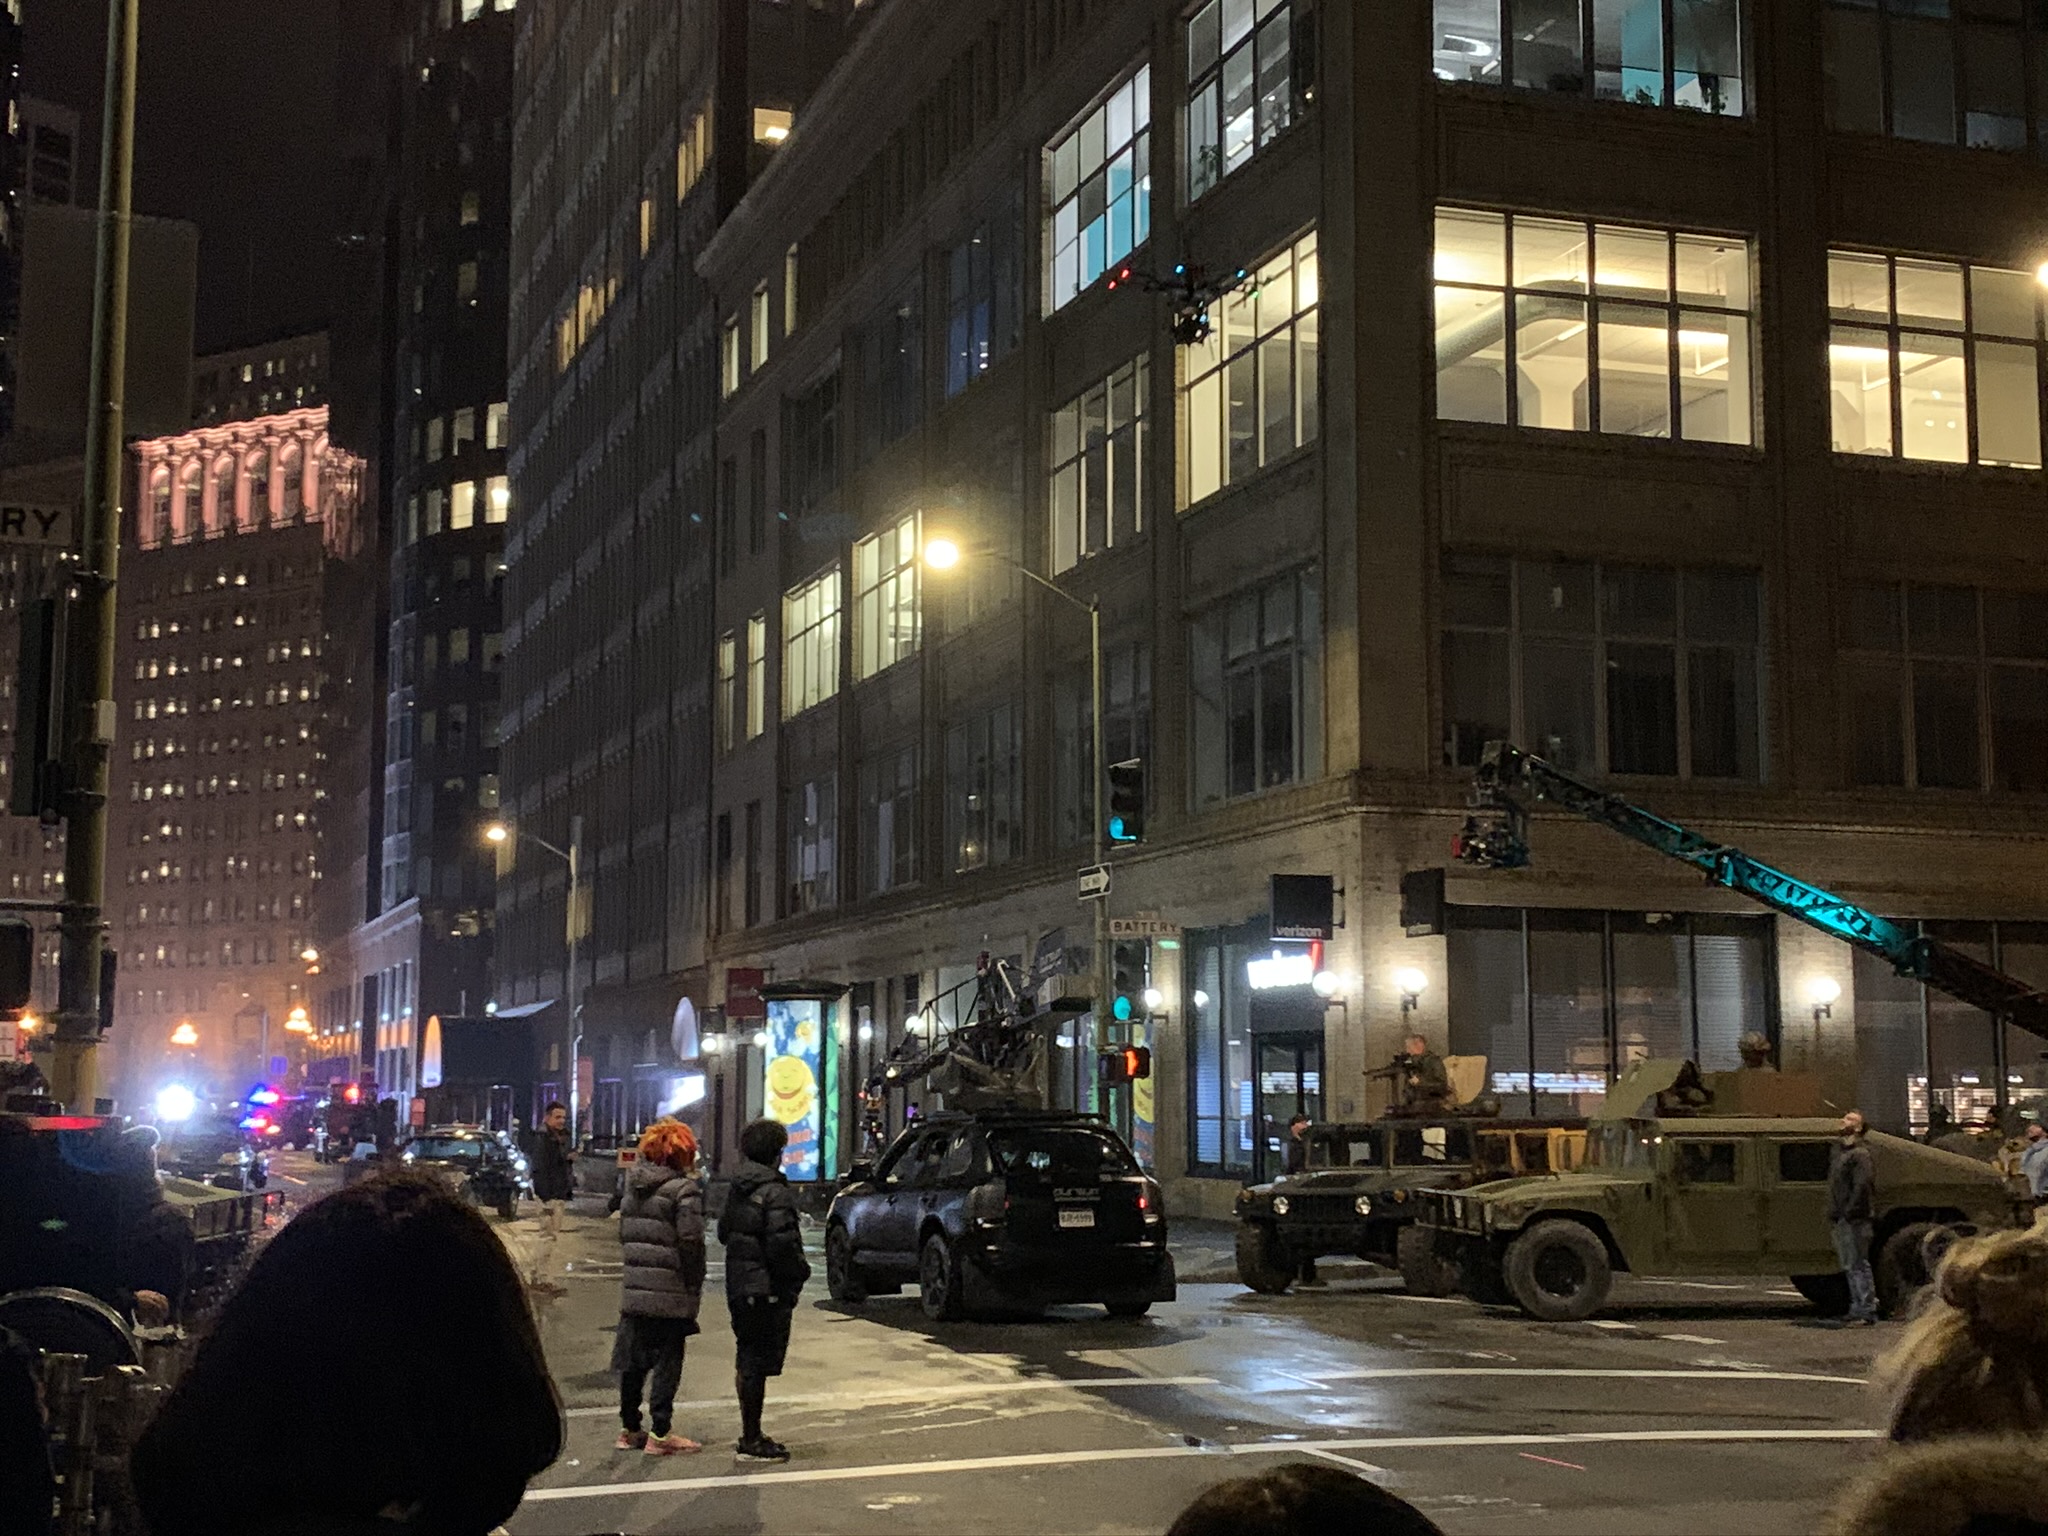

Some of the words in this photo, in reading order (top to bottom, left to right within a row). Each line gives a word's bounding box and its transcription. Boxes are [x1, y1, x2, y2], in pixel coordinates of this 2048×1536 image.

[2, 507, 61, 539] RY
[1114, 921, 1177, 932] BATTERY
[1276, 925, 1322, 937] verizon
